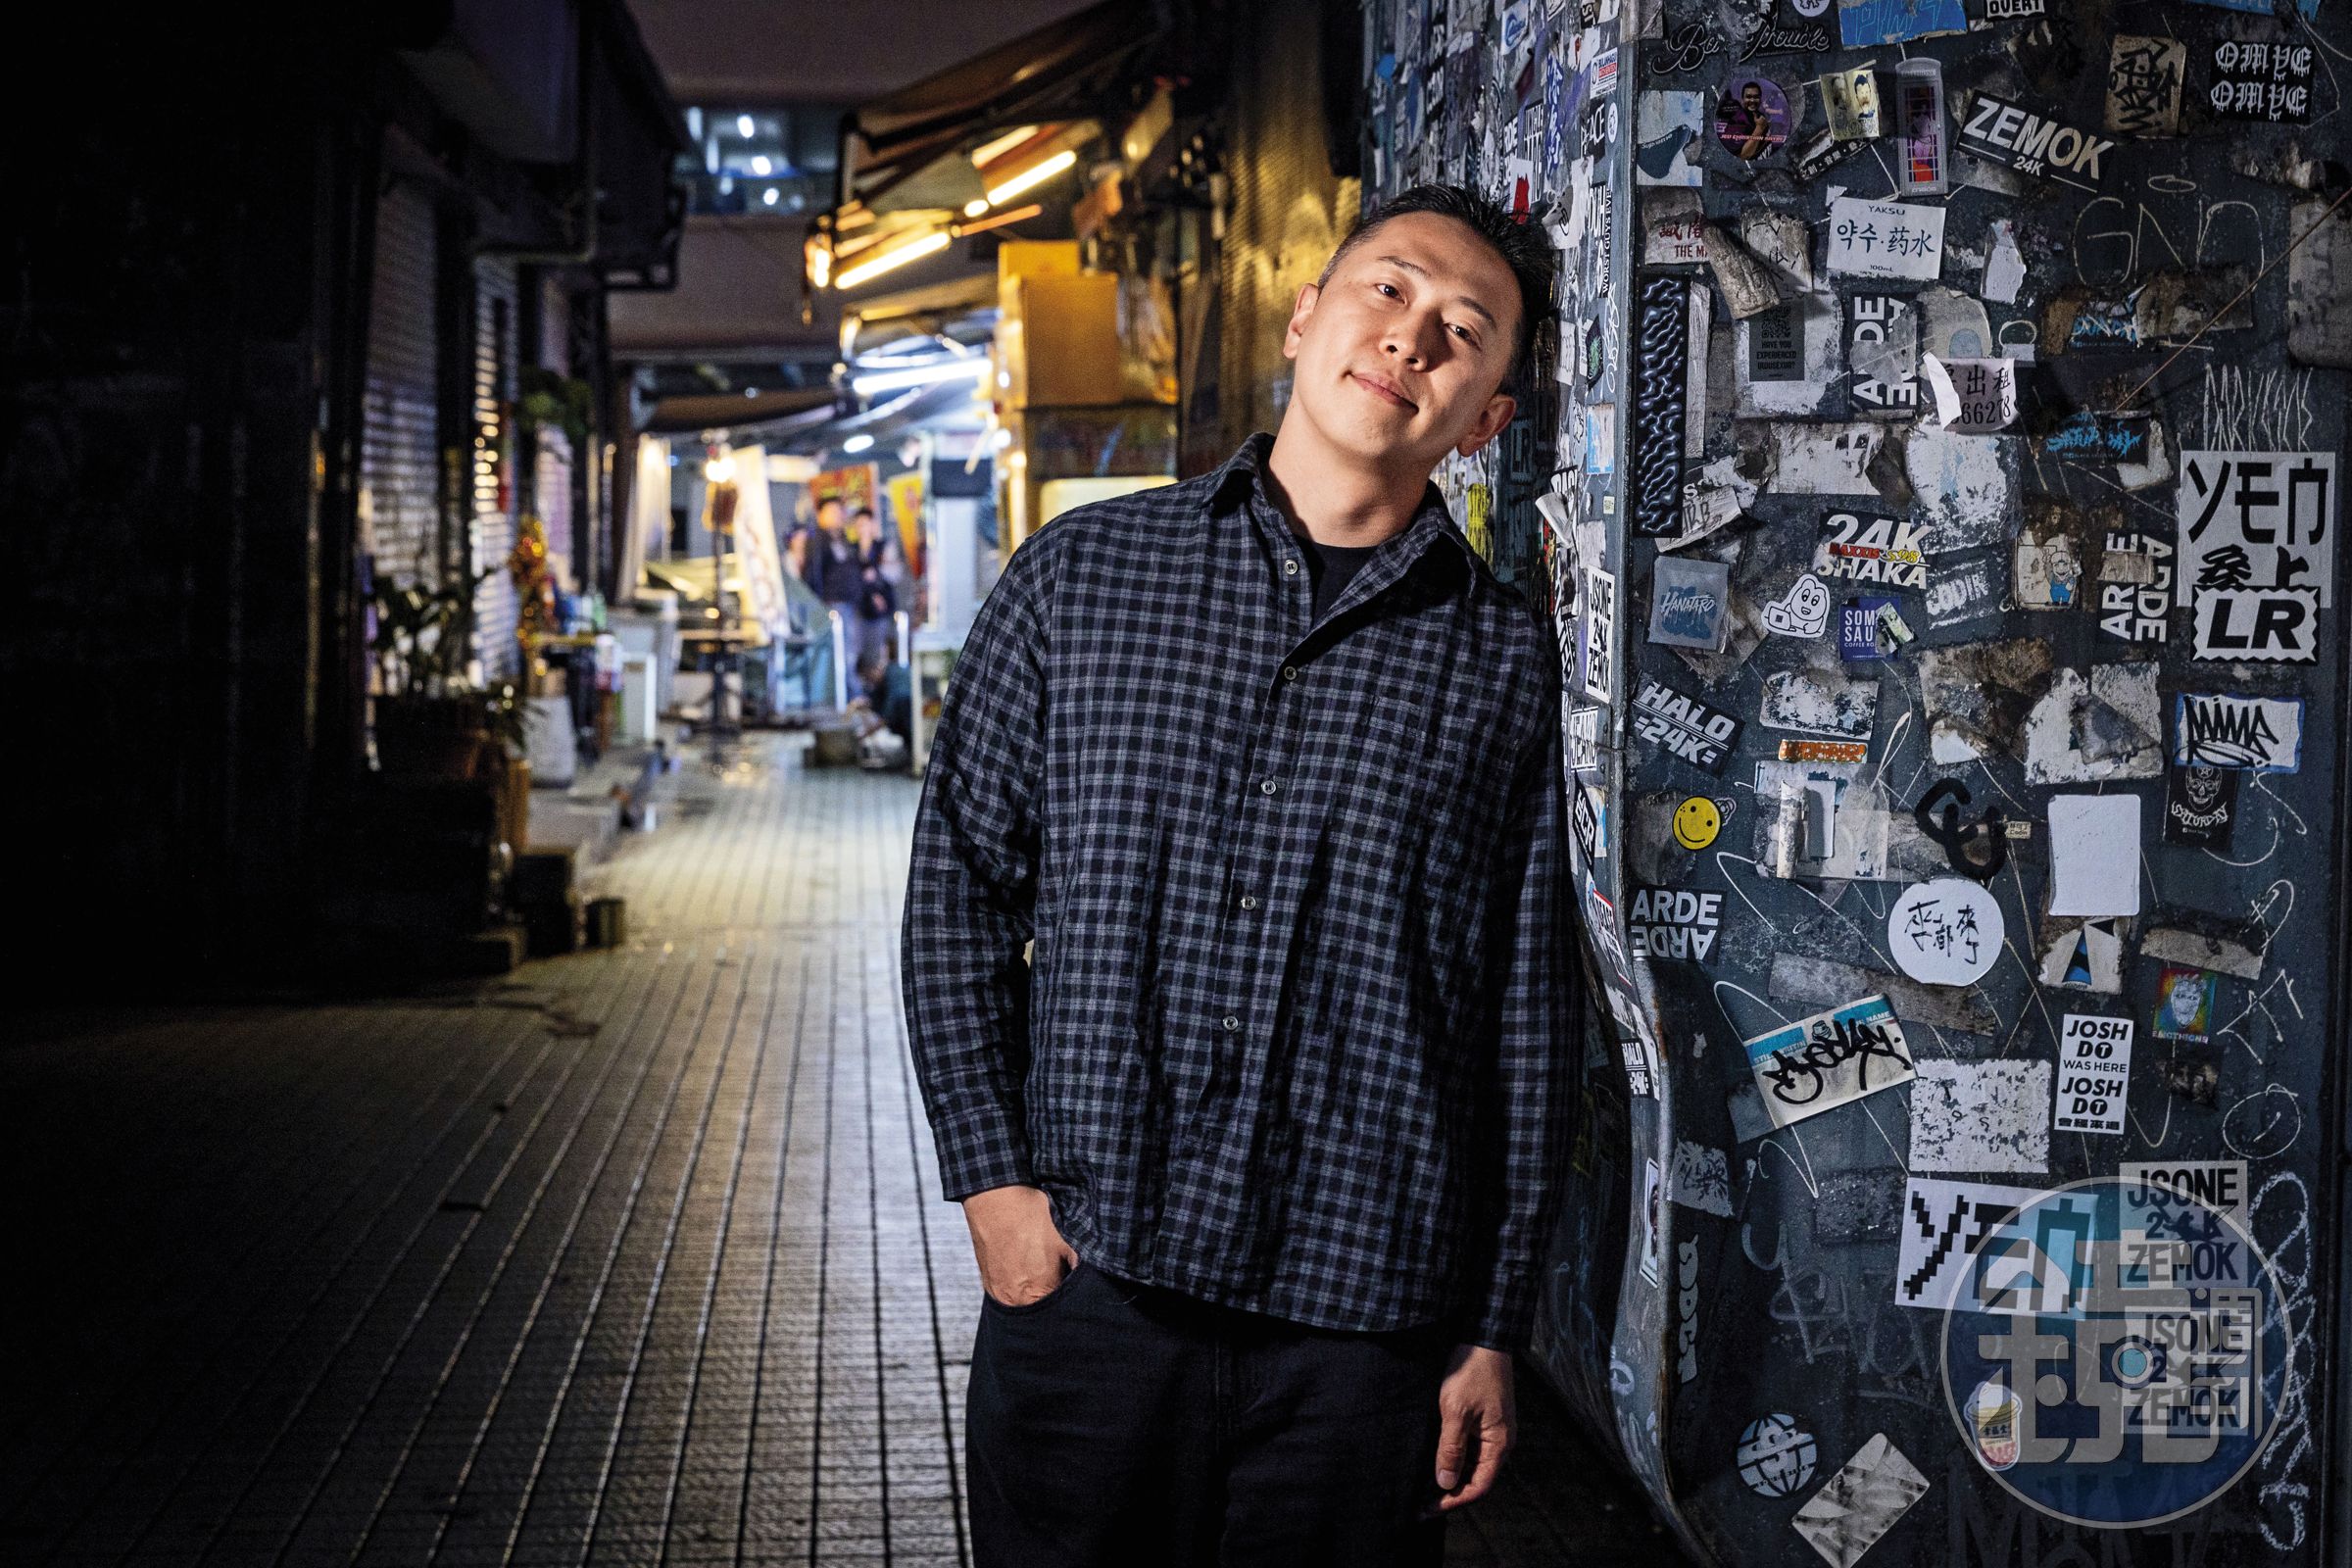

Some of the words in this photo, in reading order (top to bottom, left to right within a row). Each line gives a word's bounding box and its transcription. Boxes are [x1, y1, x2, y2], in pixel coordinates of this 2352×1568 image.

[1963, 97, 2114, 179] ZEMOK
[2013, 156, 2044, 177] 24K
[1868, 205, 1906, 216] YAKSU
[1675, 245, 1692, 258] THE
[1696, 245, 1707, 258] M
[1950, 395, 2011, 425] 66278
[1827, 514, 1935, 563] 24K
[1817, 554, 1927, 590] SHAKA
[2100, 533, 2138, 640] ARE
[1844, 610, 1875, 625] SOM
[1844, 626, 1874, 642] SAU
[2206, 598, 2307, 650] LR
[1641, 682, 1736, 740] HALO
[1631, 890, 1722, 926] ARDE
[2067, 1020, 2129, 1041] JOSH
[2063, 1059, 2091, 1071] WAS
[2094, 1062, 2128, 1073] HERE
[2061, 1077, 2124, 1098] JOSH
[2128, 1168, 2239, 1207] JSONE
[2127, 1243, 2239, 1282] ZEMOK
